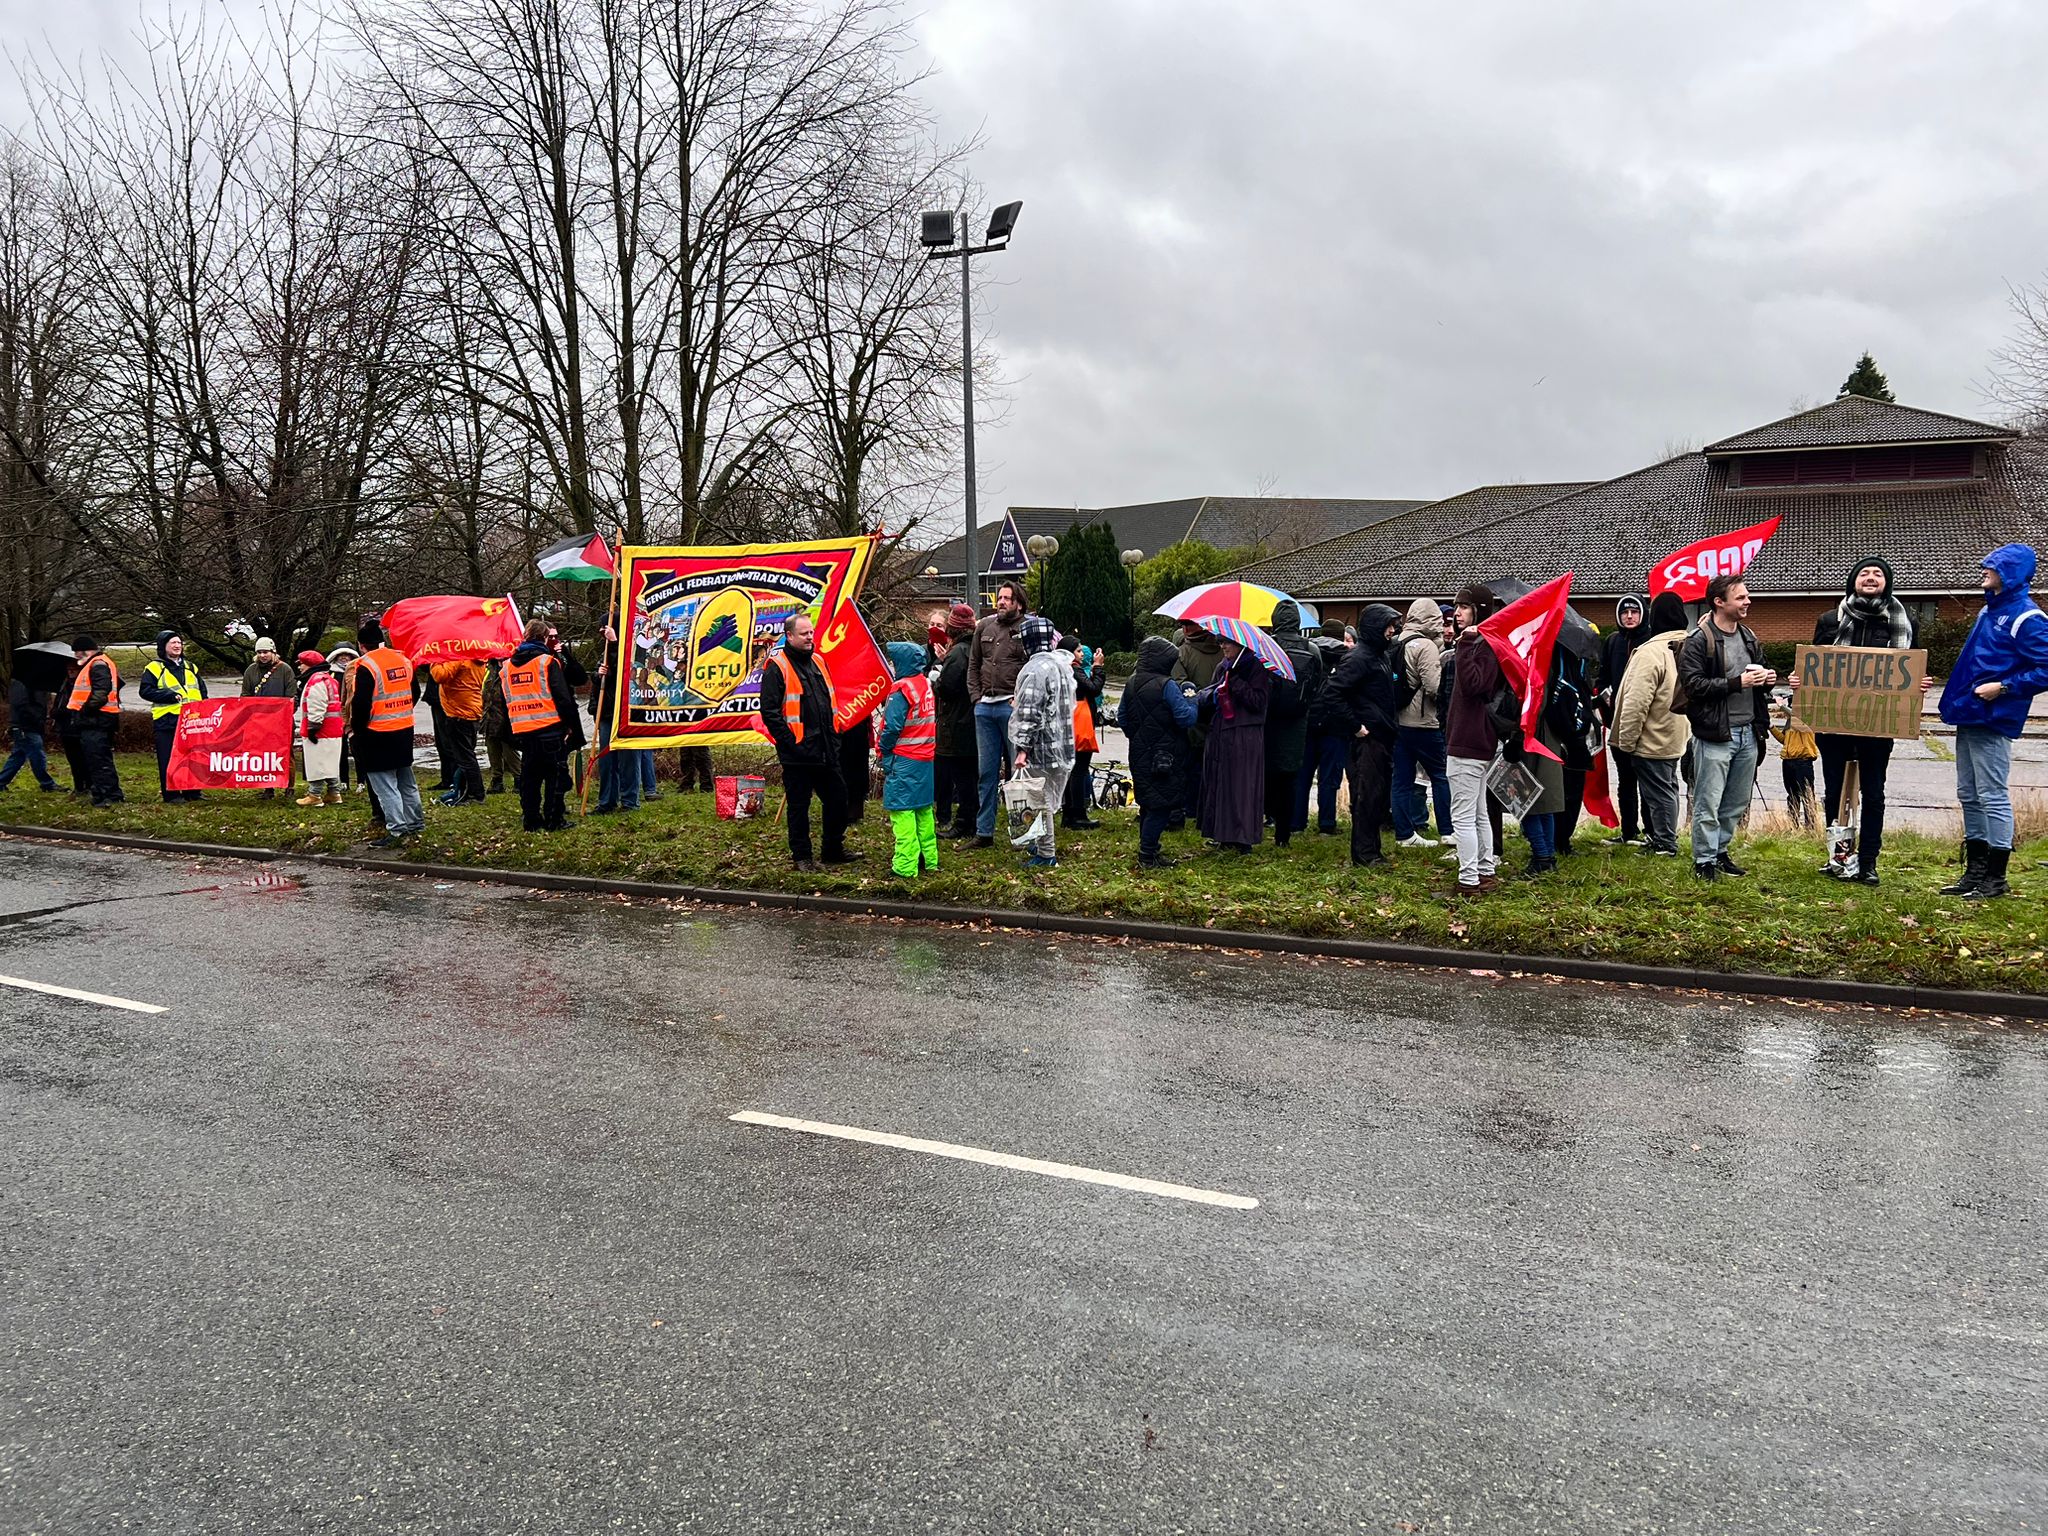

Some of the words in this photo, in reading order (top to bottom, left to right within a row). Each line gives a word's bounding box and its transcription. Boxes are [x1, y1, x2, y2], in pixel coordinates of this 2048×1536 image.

[645, 583, 685, 606] GENERAL
[686, 571, 744, 589] FEDERATION
[747, 571, 780, 584] TRADE
[780, 575, 819, 597] UNIONS
[695, 662, 741, 680] GFTU
[1803, 652, 1912, 691] REFUGEES
[630, 688, 686, 699] SOLIDARITY
[182, 716, 223, 728] Community
[645, 709, 697, 723] UNITY
[209, 751, 285, 772] Norfolk
[235, 773, 277, 782] branch
